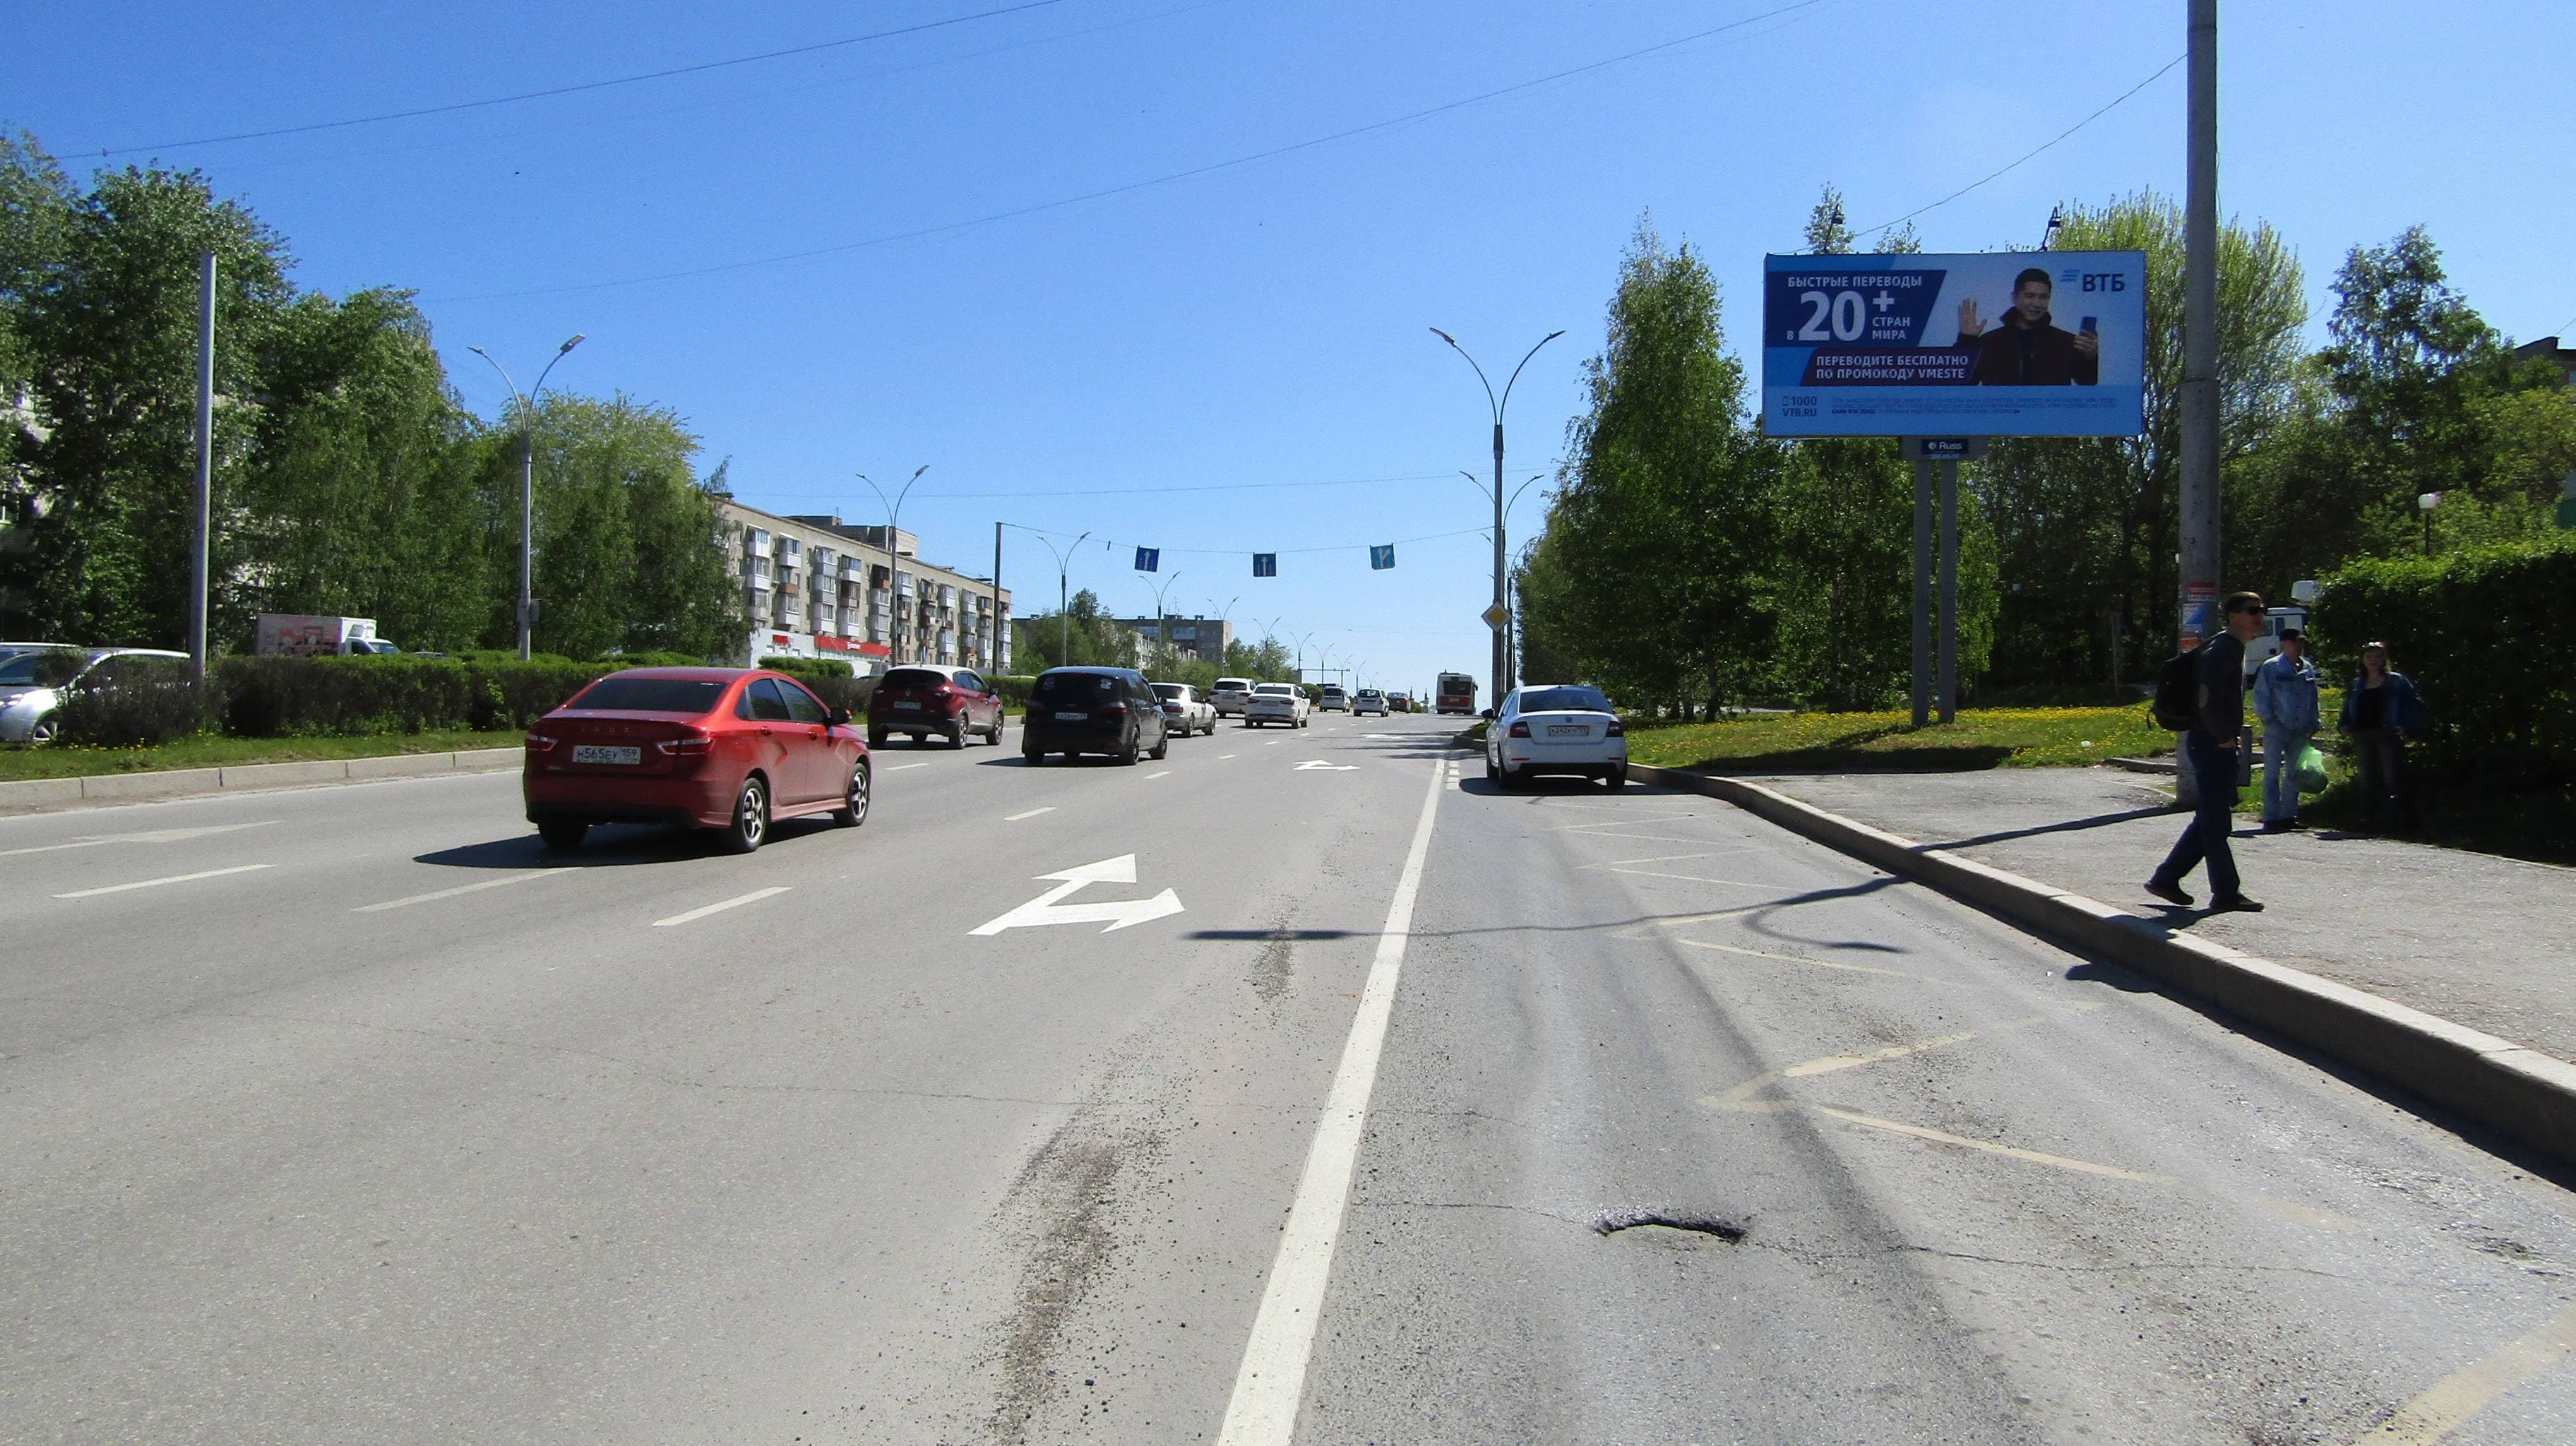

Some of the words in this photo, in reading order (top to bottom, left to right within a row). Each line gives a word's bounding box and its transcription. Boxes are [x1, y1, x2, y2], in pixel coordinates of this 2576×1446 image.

[1788, 276, 1849, 287] БЫСТРЫЕ
[1853, 276, 1921, 288] ПЕРЕВОДЫ
[2082, 274, 2125, 292] ВТБ
[1873, 317, 1910, 326] СТРАН
[1872, 330, 1907, 340] МИРА
[1816, 356, 1893, 367] ПЕРЕВОДИТЕ
[1897, 355, 1968, 366] БЕСПЛАТНО
[1816, 369, 1833, 378] ПО
[1837, 369, 1914, 380] ПРОМОКОДУ
[1919, 369, 1964, 378] VMESTE
[1792, 396, 1817, 406] 1000
[1782, 408, 1817, 417] VTB.RU
[1939, 441, 1962, 450] Russ
